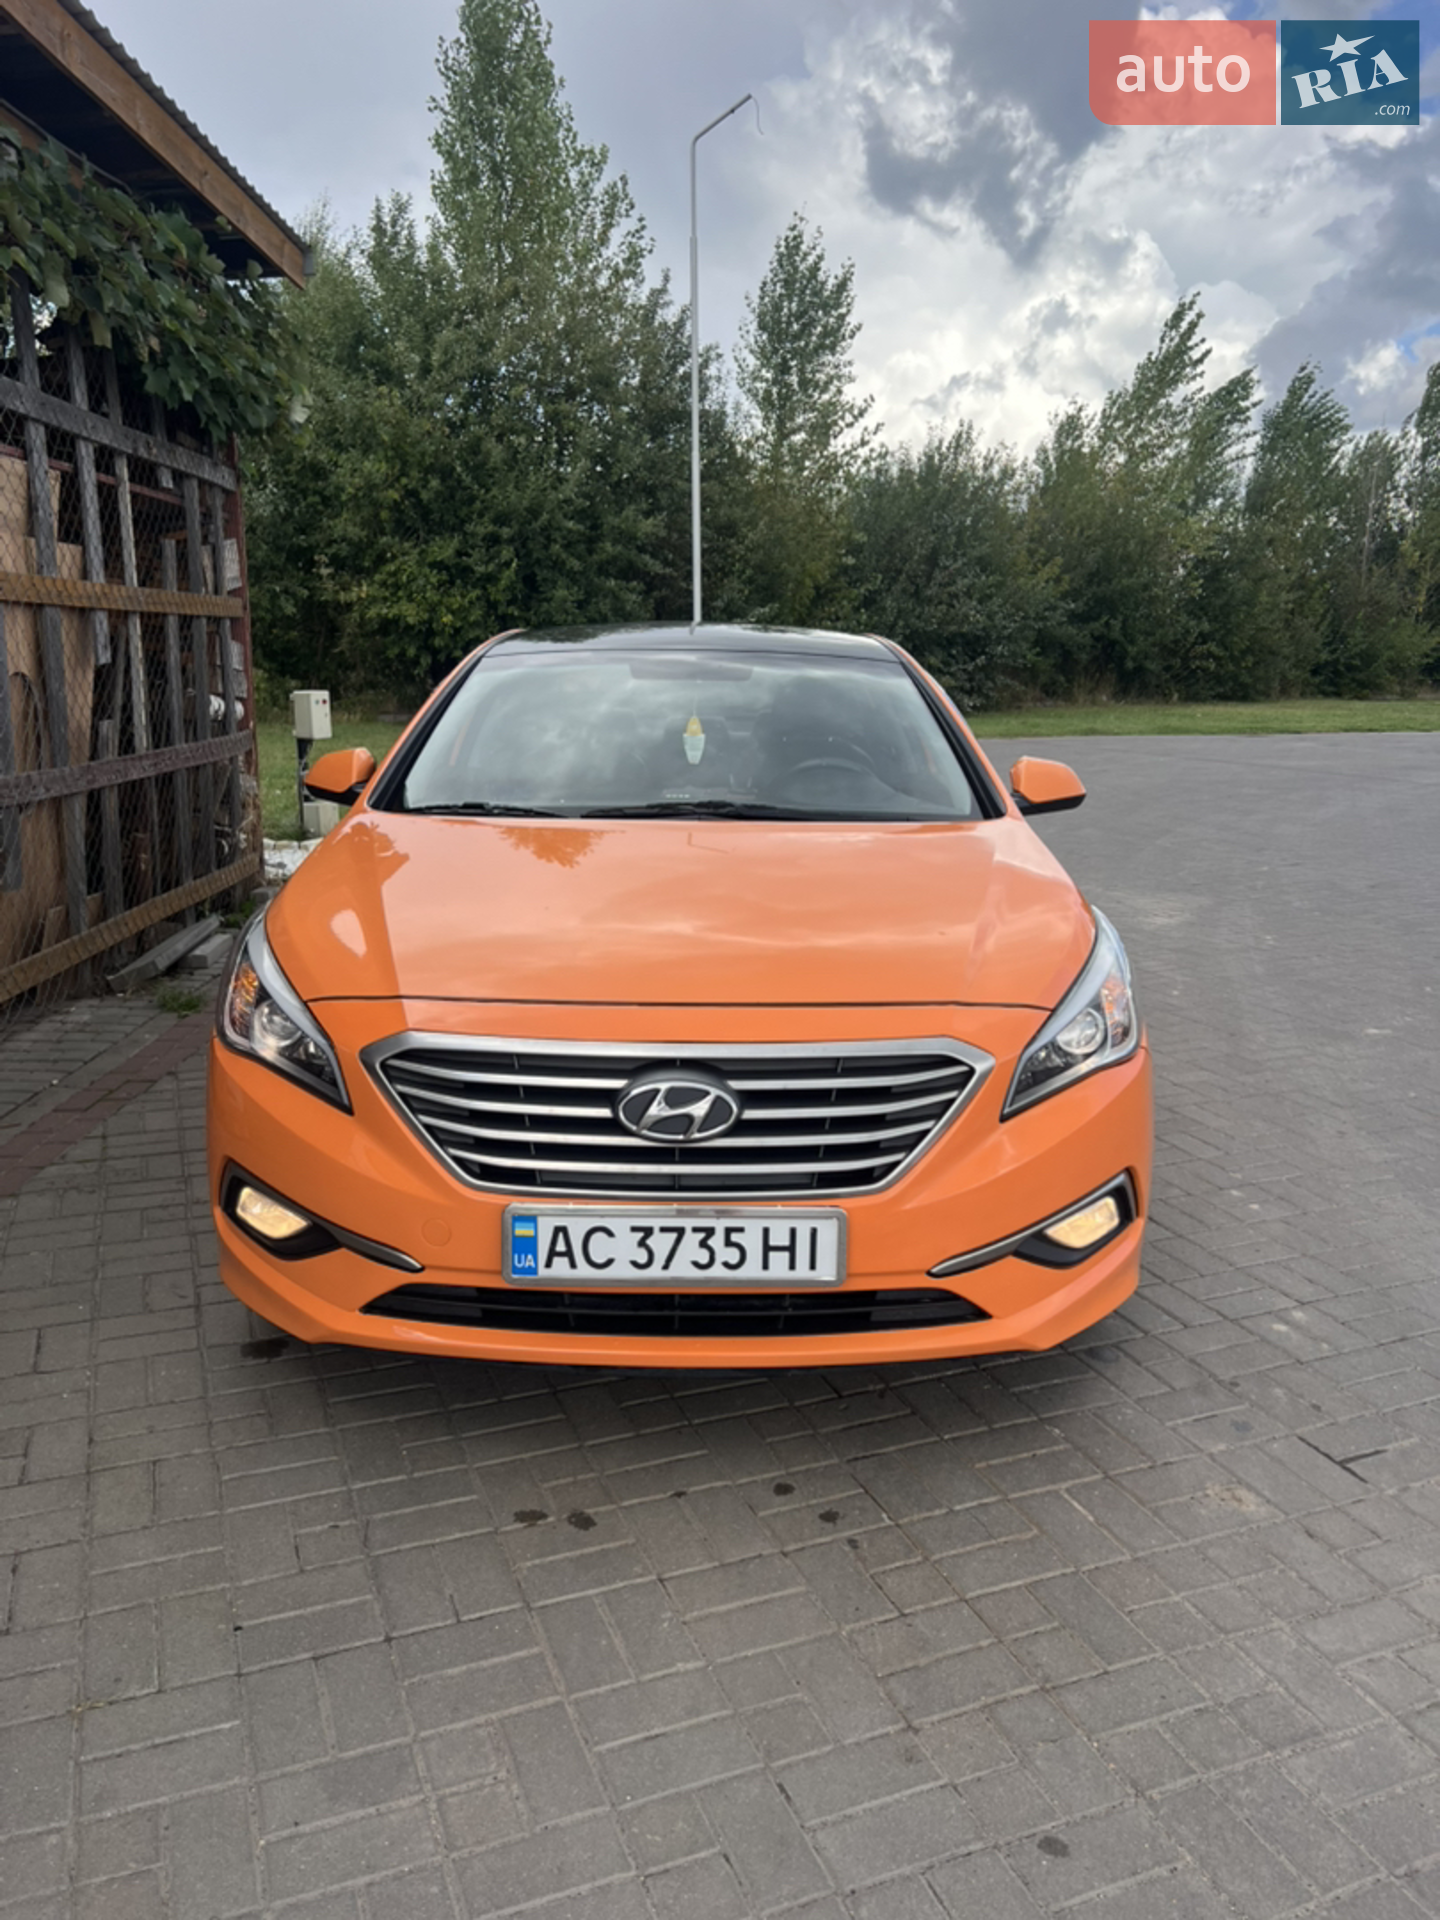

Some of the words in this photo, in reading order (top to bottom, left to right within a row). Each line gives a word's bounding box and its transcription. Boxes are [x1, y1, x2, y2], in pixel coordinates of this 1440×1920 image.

[514, 1254, 536, 1268] UA
[544, 1226, 616, 1270] AC
[628, 1226, 747, 1271] 3735
[761, 1226, 817, 1271] HI
